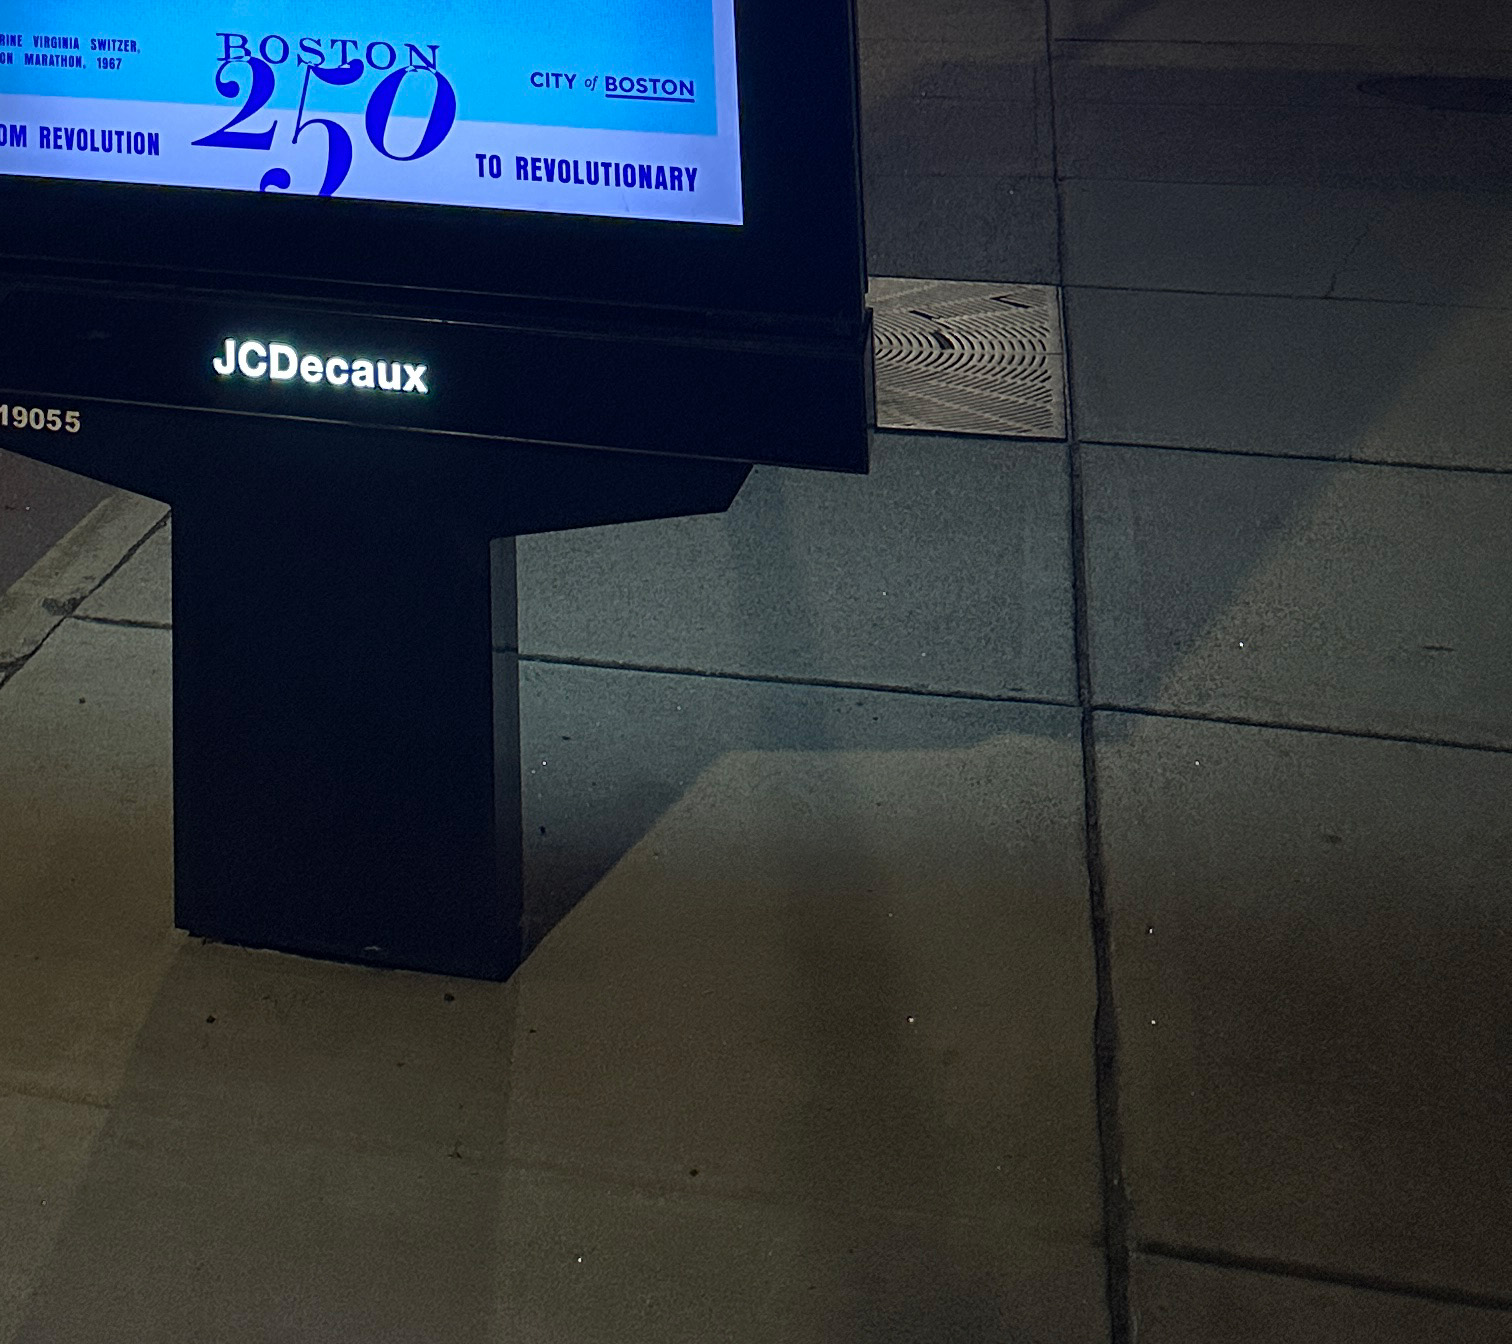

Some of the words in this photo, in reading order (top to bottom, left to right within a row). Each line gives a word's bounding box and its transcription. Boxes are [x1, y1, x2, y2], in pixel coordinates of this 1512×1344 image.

[24, 53, 86, 69] MARATHON,
[96, 57, 122, 70] 1967
[33, 35, 80, 50] VIRGINIA
[90, 38, 141, 54] SWITZER,
[216, 32, 440, 70] BOSTON
[530, 71, 577, 89] CITY
[584, 75, 598, 91] of
[605, 76, 695, 96] BOSTON
[39, 125, 160, 156] REVOLUTION
[191, 56, 457, 197] 250
[475, 153, 501, 178] TO
[516, 156, 698, 192] REVOLUTIONARY
[212, 337, 429, 394] JCDecaux
